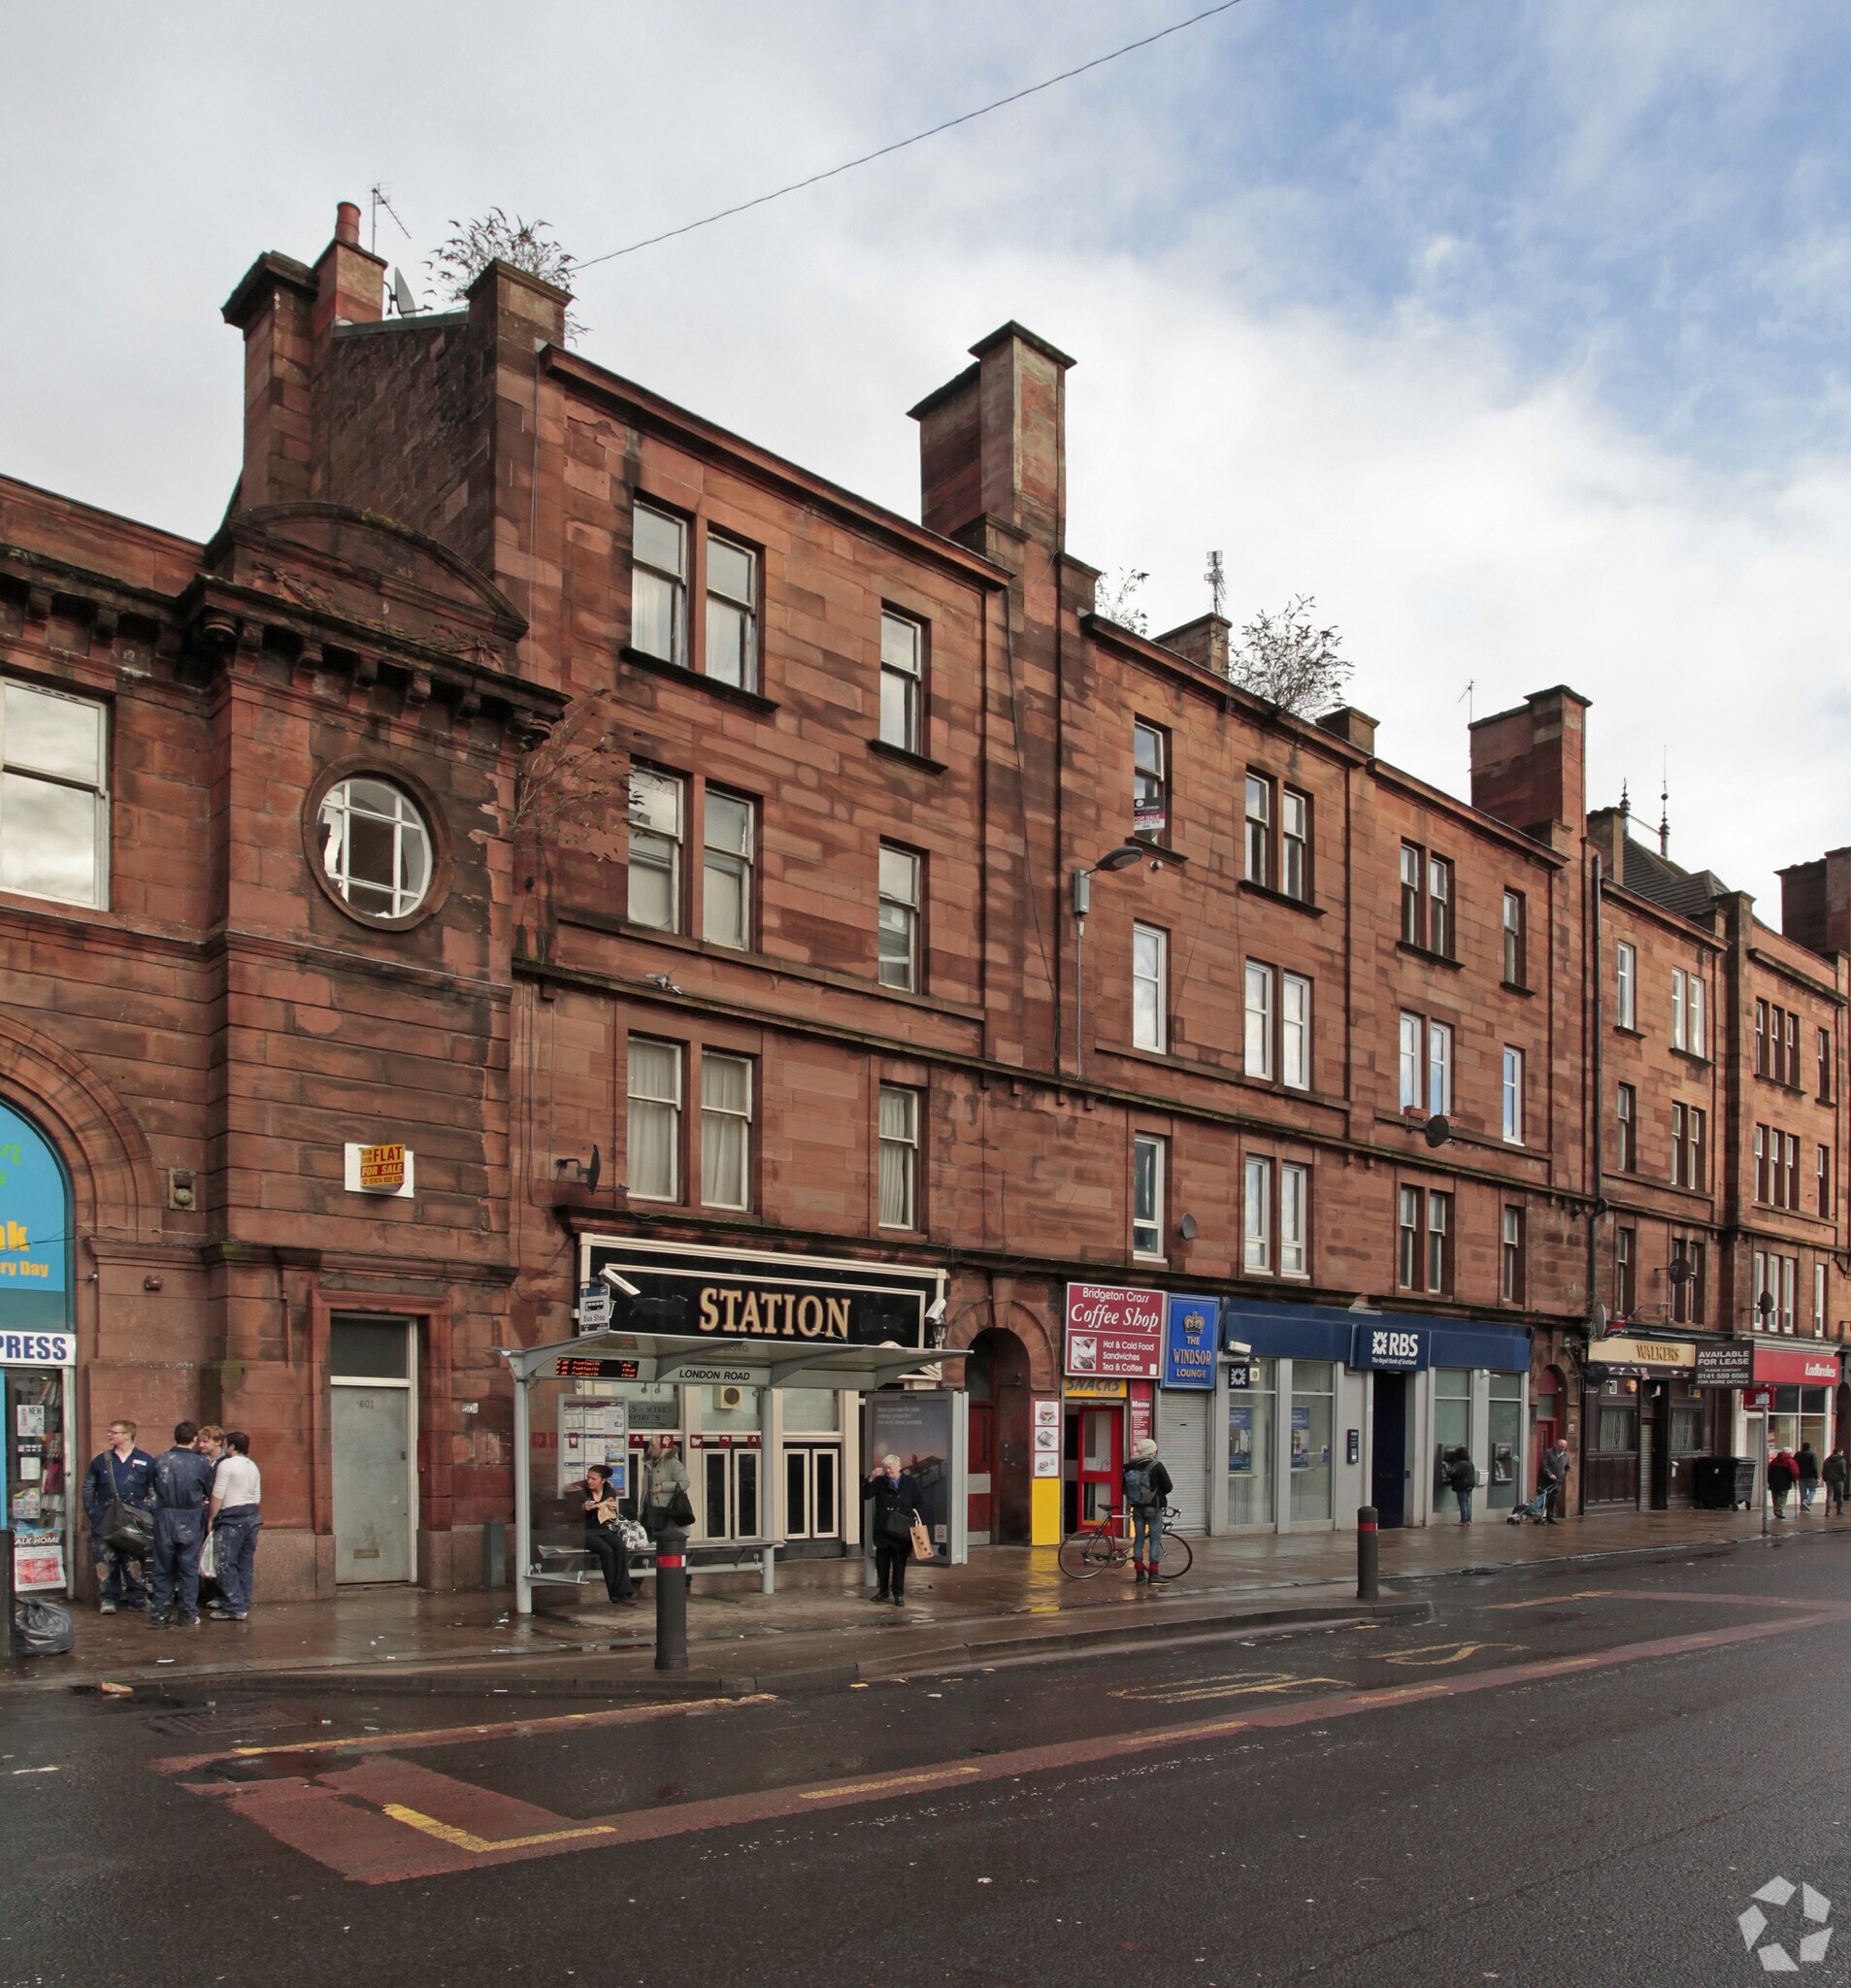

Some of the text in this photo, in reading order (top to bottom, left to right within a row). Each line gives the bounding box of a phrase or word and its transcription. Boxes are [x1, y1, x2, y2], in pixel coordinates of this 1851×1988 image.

[374, 1146, 403, 1162] FLAT
[362, 1164, 402, 1176] FOR SALE
[20, 1260, 49, 1278] Day
[1083, 1287, 1149, 1303] Bridgeton Cross
[699, 1287, 851, 1337] STATION
[1071, 1303, 1158, 1333] Coffee Shop
[1138, 1342, 1154, 1351] Food
[1186, 1336, 1200, 1345] THE
[1389, 1332, 1418, 1357] RBS
[1103, 1351, 1140, 1361] Sandwiches
[1173, 1349, 1212, 1365] WINDSOR
[1636, 1345, 1679, 1361] WALKERS
[1122, 1364, 1143, 1372] Coffee
[1176, 1368, 1206, 1378] LOUNGE
[679, 1369, 750, 1381] LONDON ROAD
[1066, 1378, 1120, 1391] SNACKS
[28, 1406, 42, 1415] NEW
[34, 1536, 60, 1545] HOME
